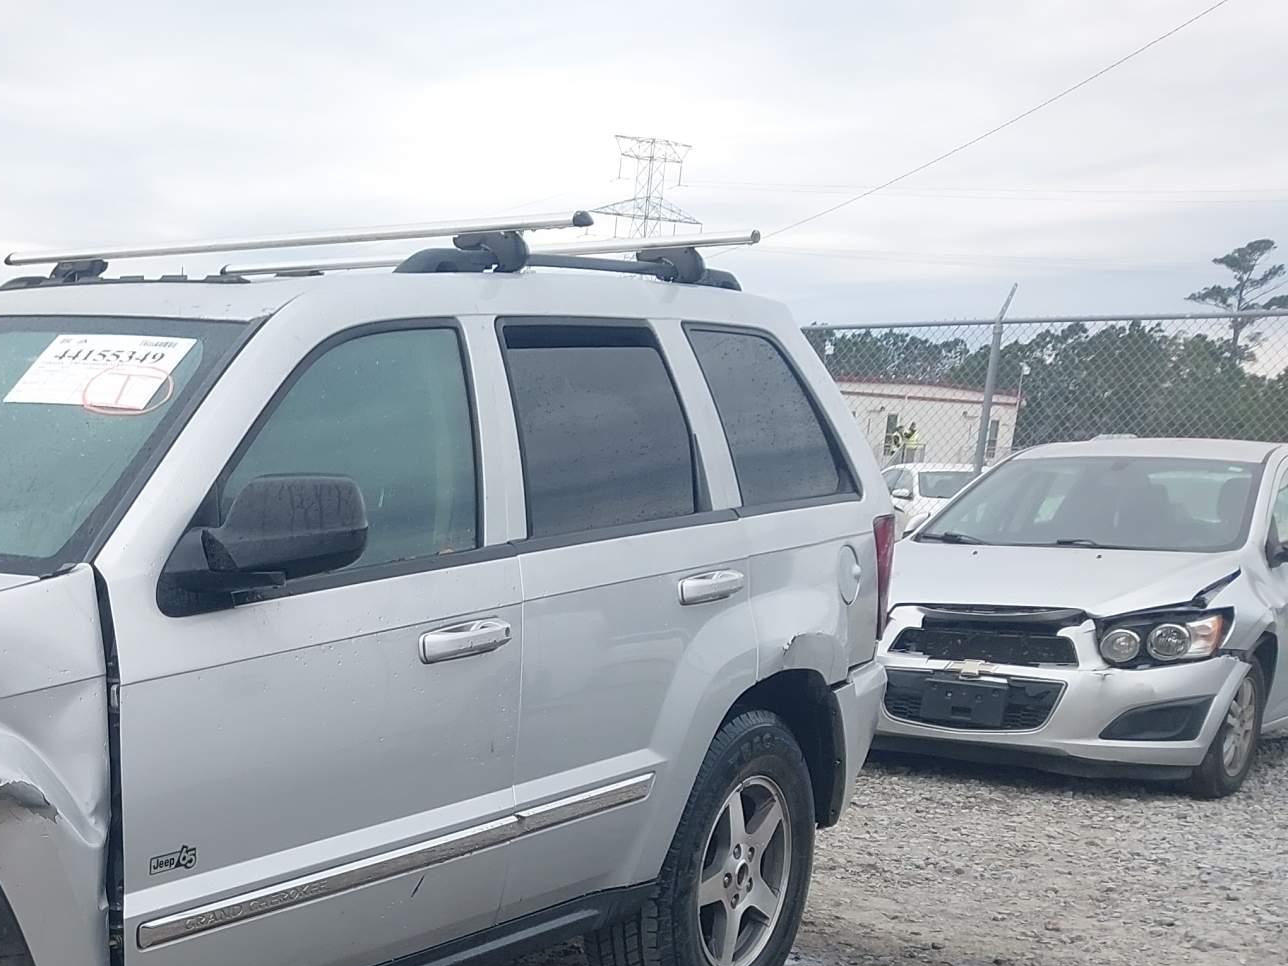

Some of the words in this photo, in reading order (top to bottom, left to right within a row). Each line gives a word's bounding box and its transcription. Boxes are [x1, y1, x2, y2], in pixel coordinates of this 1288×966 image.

[54, 348, 166, 364] 44155349
[152, 857, 175, 871] Jeep
[179, 845, 197, 869] 65
[184, 904, 243, 931] GRAND
